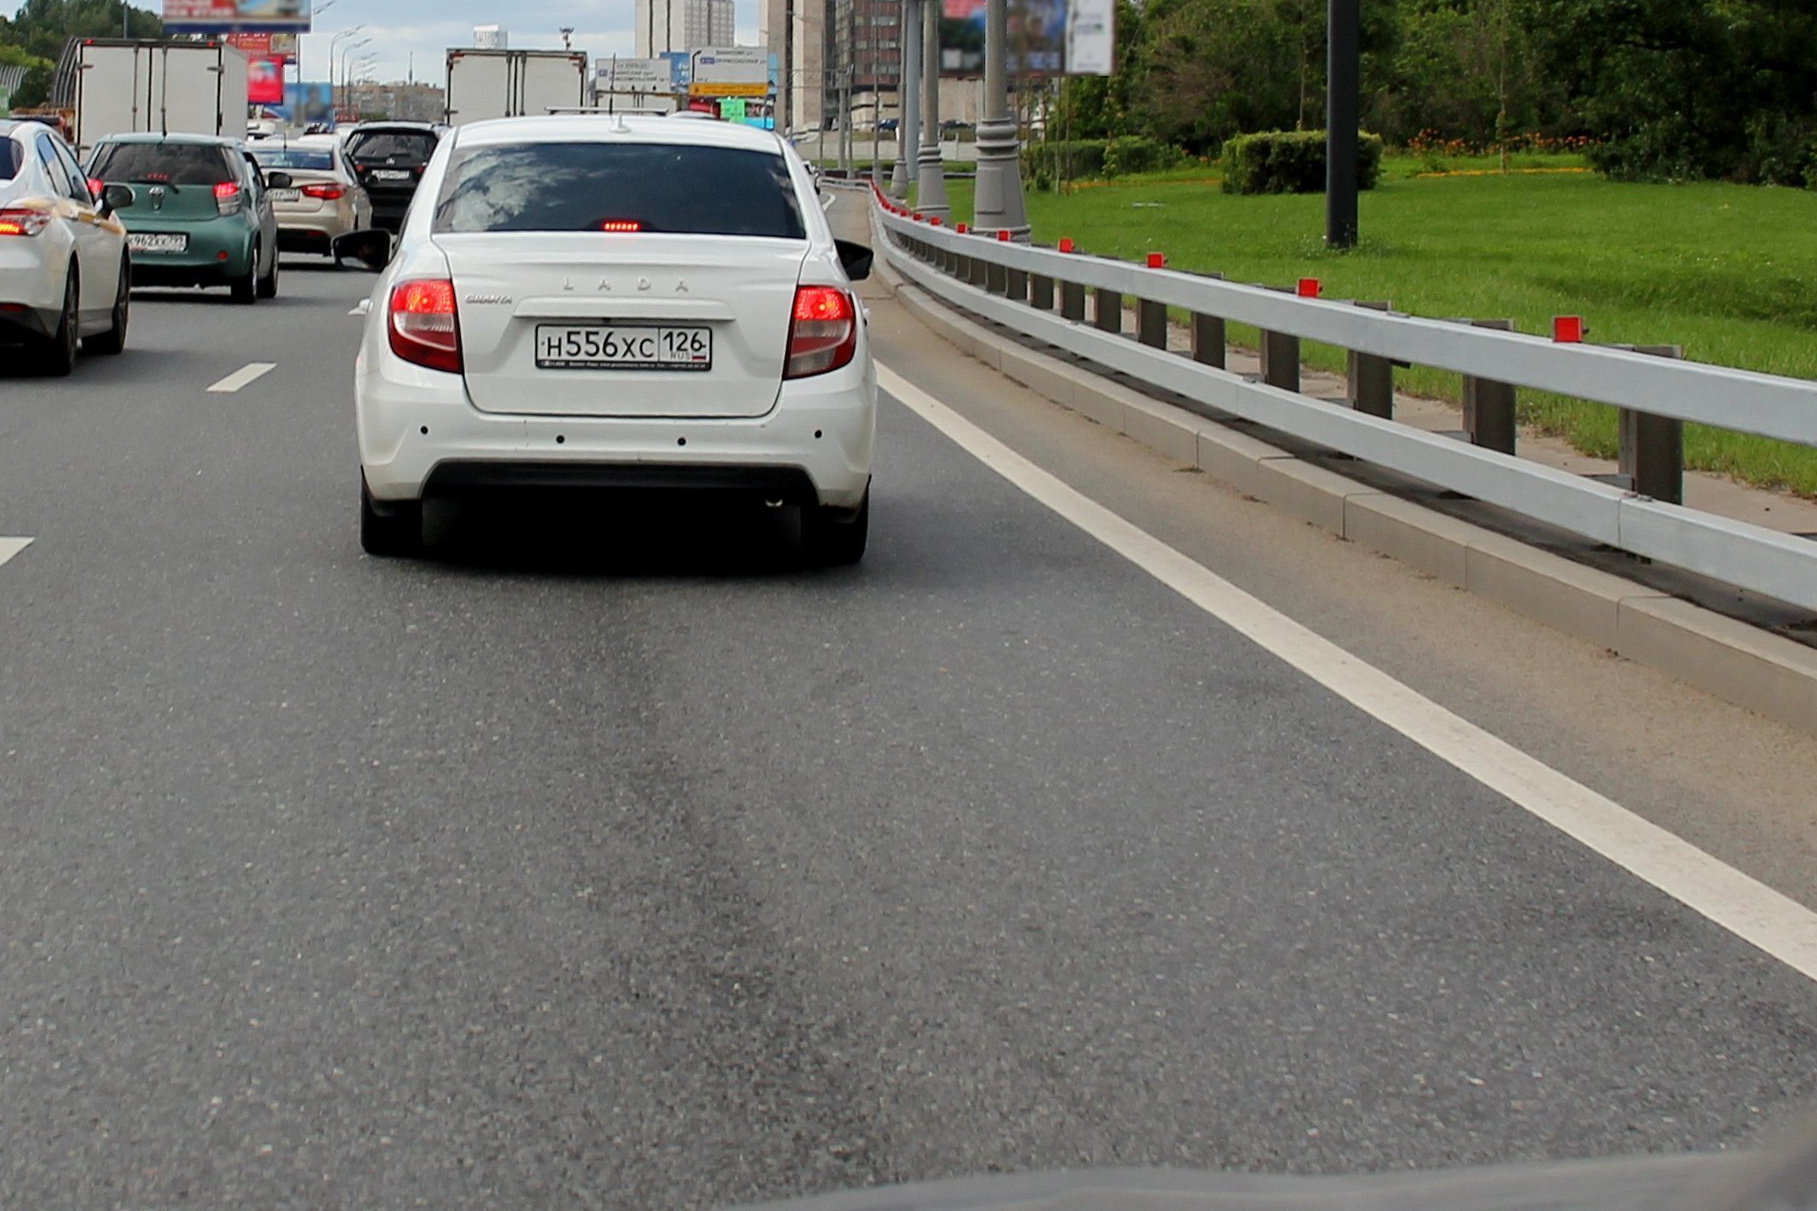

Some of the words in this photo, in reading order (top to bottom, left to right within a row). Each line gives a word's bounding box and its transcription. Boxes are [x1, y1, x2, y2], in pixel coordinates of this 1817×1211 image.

[563, 277, 689, 291] LADA
[662, 331, 702, 352] 126
[670, 351, 691, 360] RUS
